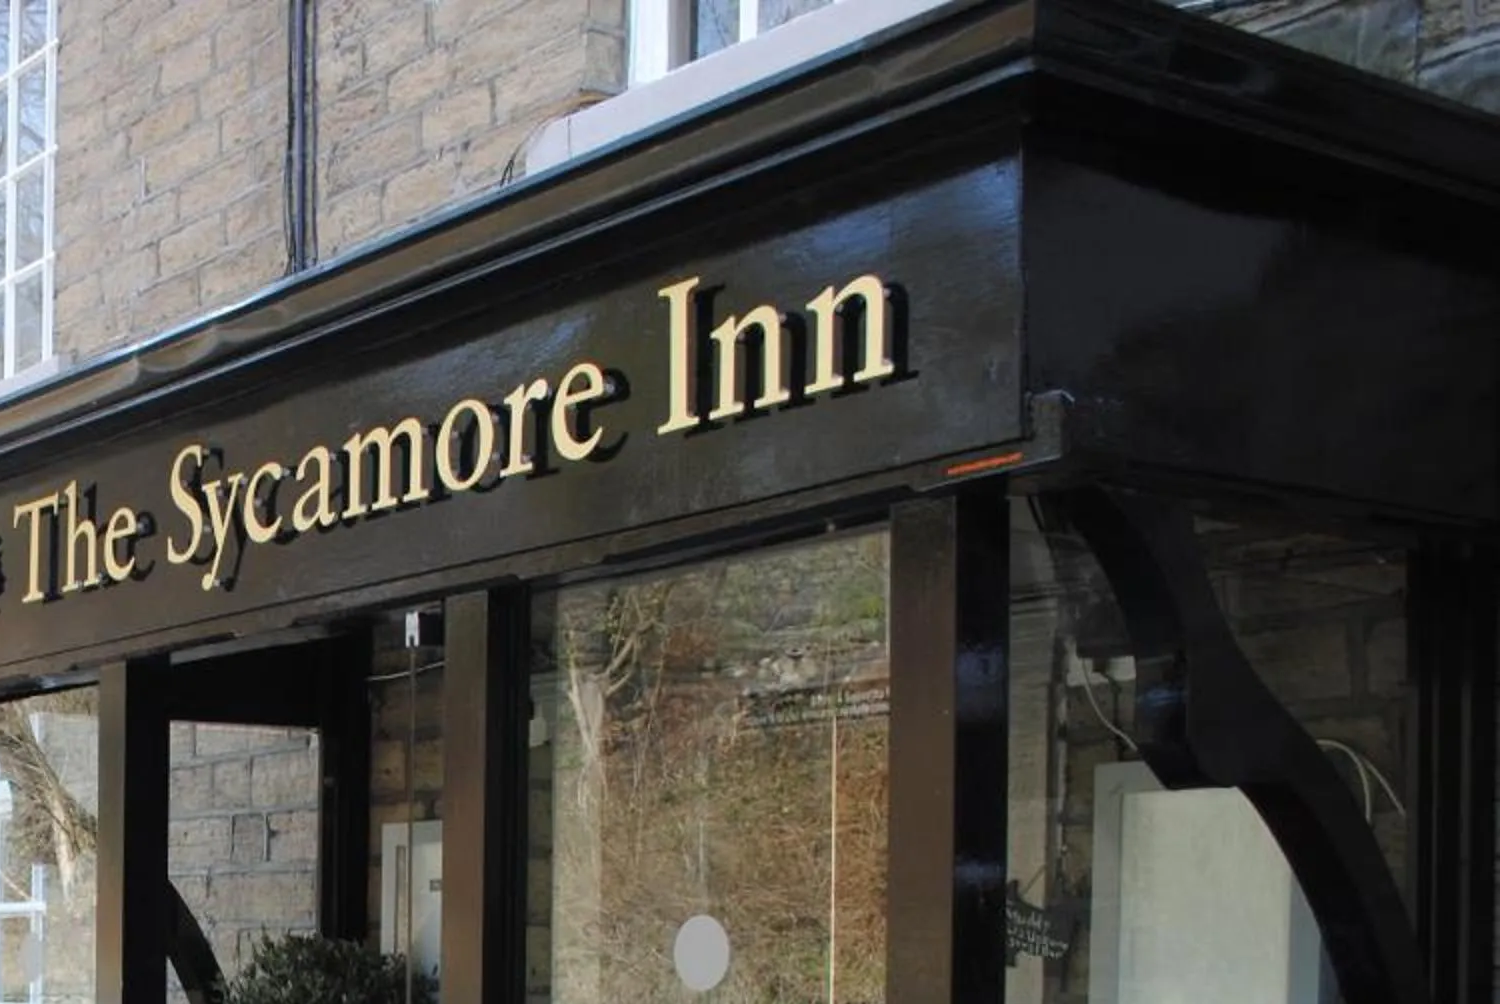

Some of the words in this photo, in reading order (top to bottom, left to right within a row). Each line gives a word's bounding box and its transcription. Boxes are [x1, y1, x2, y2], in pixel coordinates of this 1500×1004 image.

[13, 480, 137, 605] The
[167, 358, 604, 591] Sycamore
[656, 273, 895, 438] Inn
